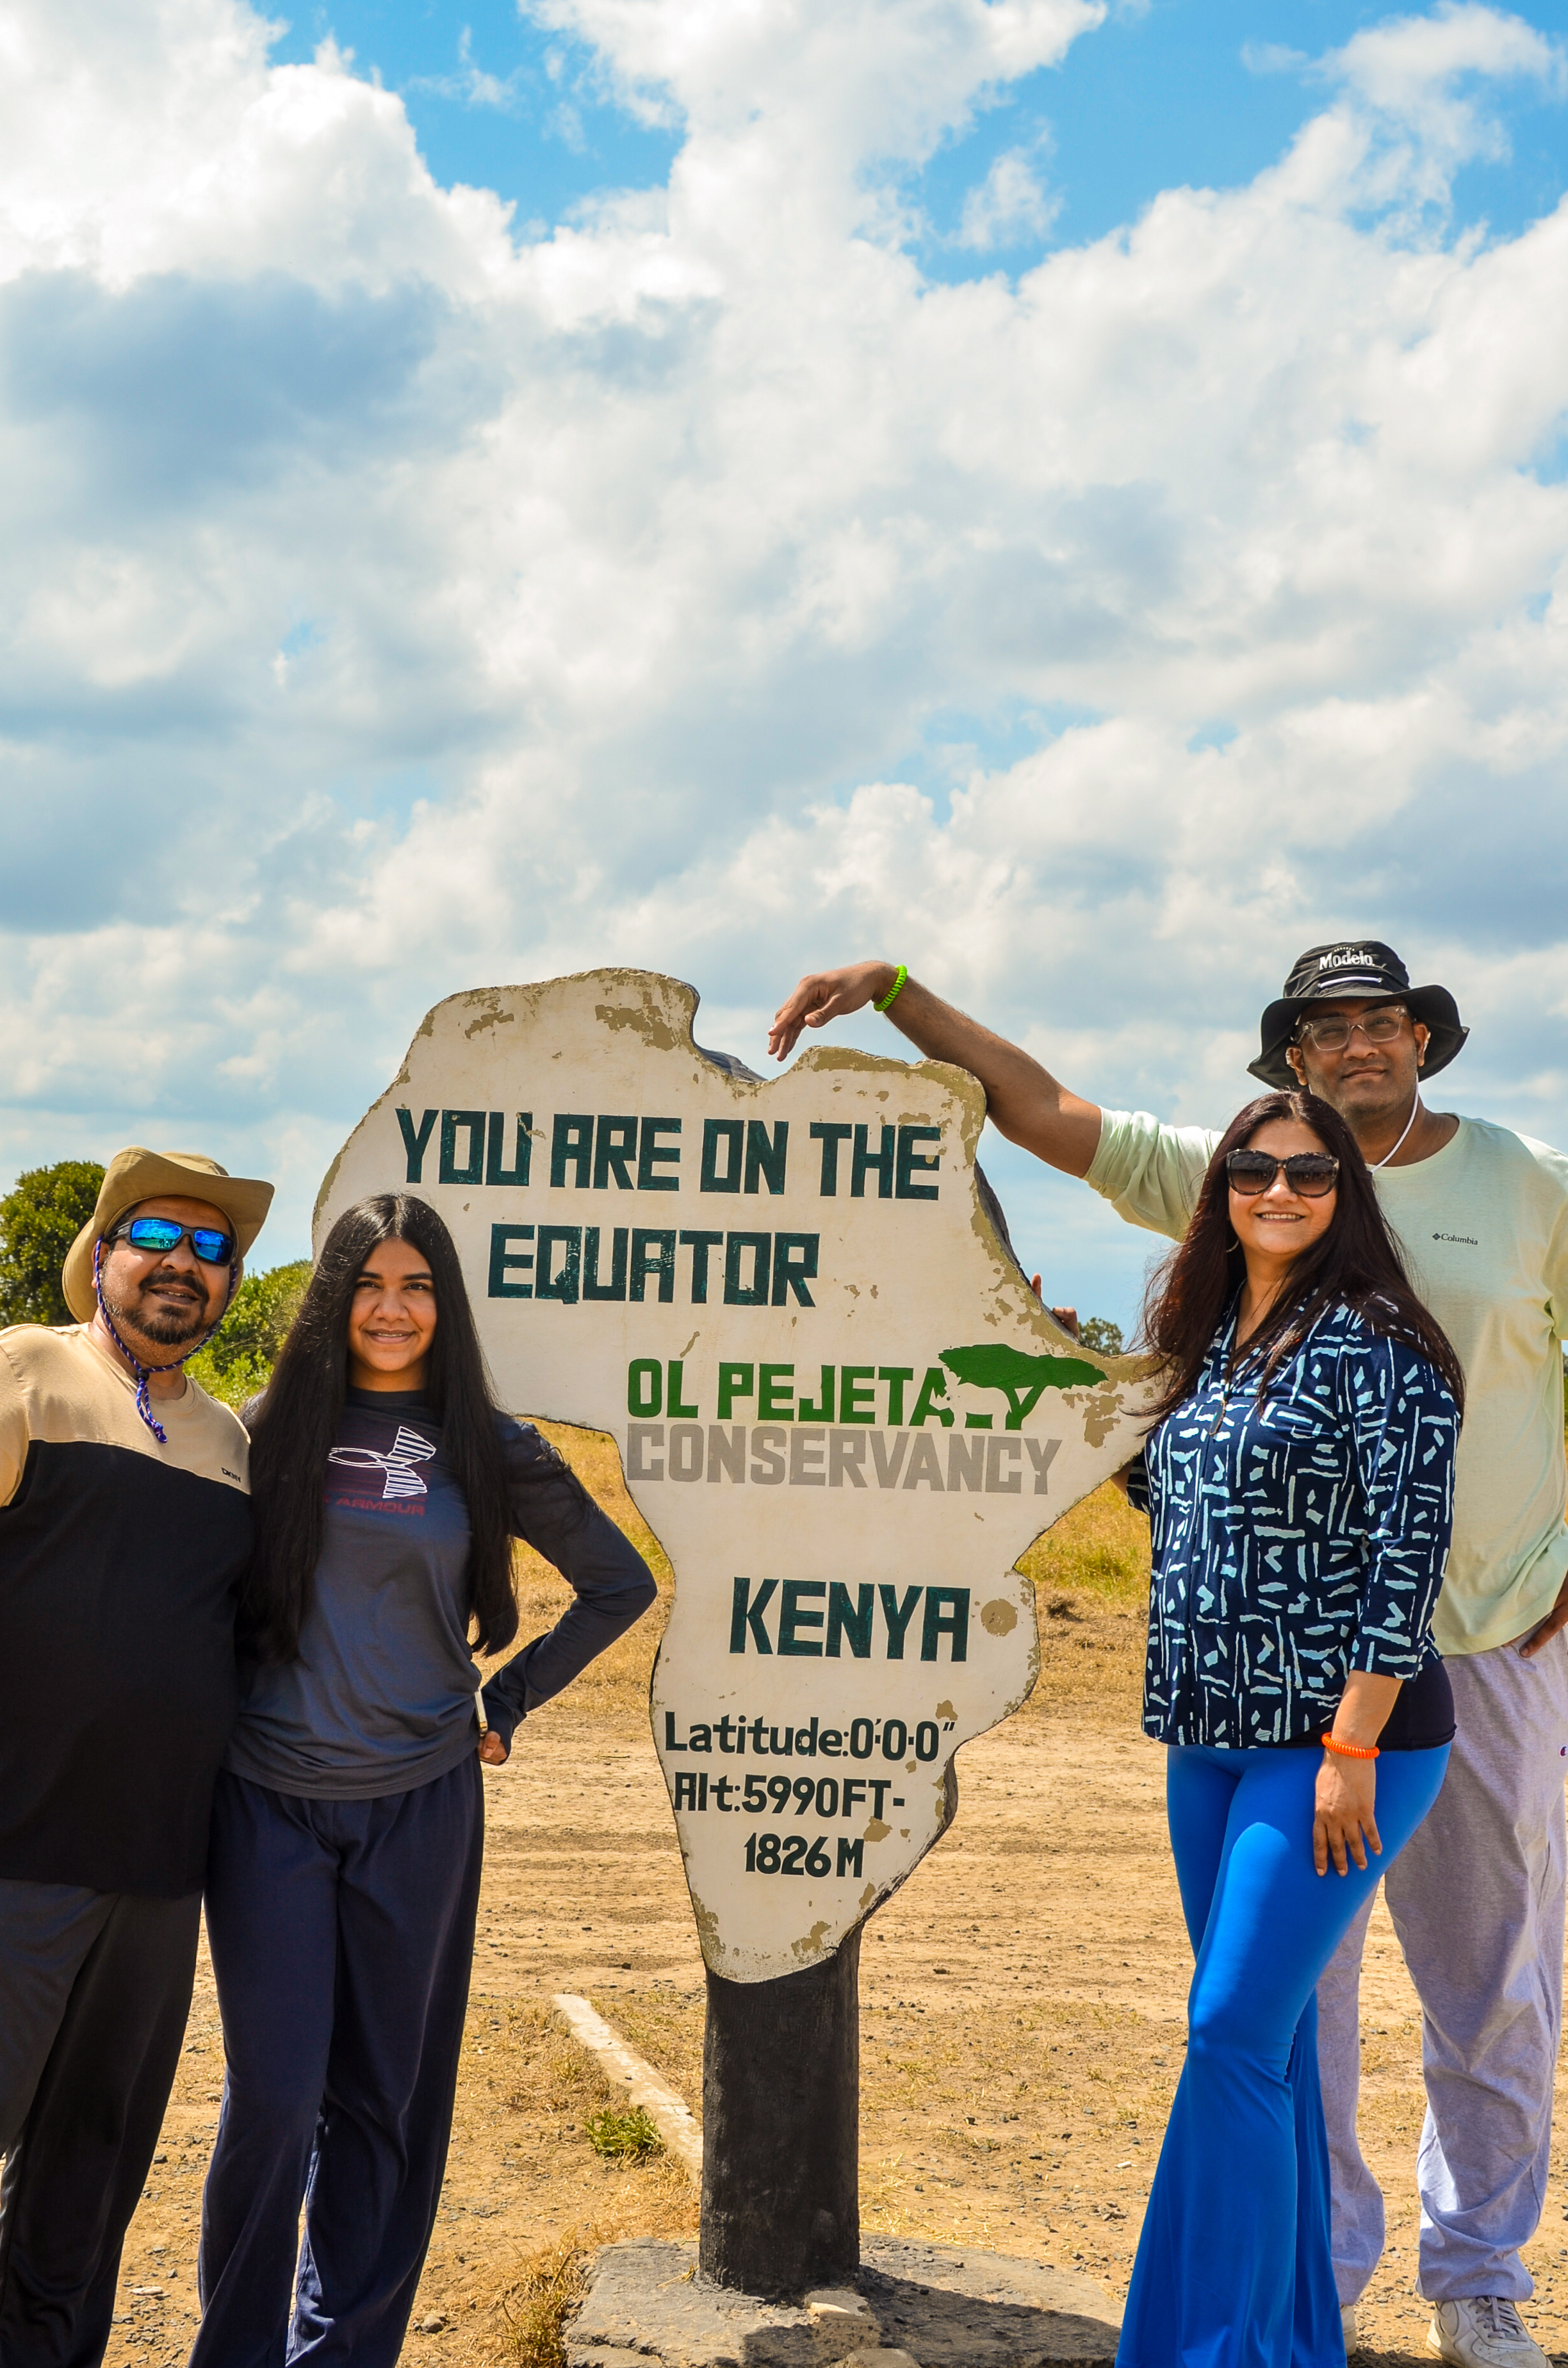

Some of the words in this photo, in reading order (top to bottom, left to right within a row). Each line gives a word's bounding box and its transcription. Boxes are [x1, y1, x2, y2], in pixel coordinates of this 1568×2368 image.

[1319, 950, 1373, 971] Modelo
[395, 1108, 533, 1187] YOU
[550, 1114, 682, 1191] ARE
[699, 1119, 789, 1196] ON
[810, 1121, 941, 1201] THE
[487, 1223, 820, 1308] EQUATOR
[1441, 1233, 1478, 1246] Columbia
[627, 1359, 699, 1418] OL
[717, 1361, 954, 1427] PEJETA
[626, 1423, 1063, 1495] CONSERVANCY
[335, 1496, 426, 1517] ARMOUR
[729, 1577, 970, 1662] KENYA
